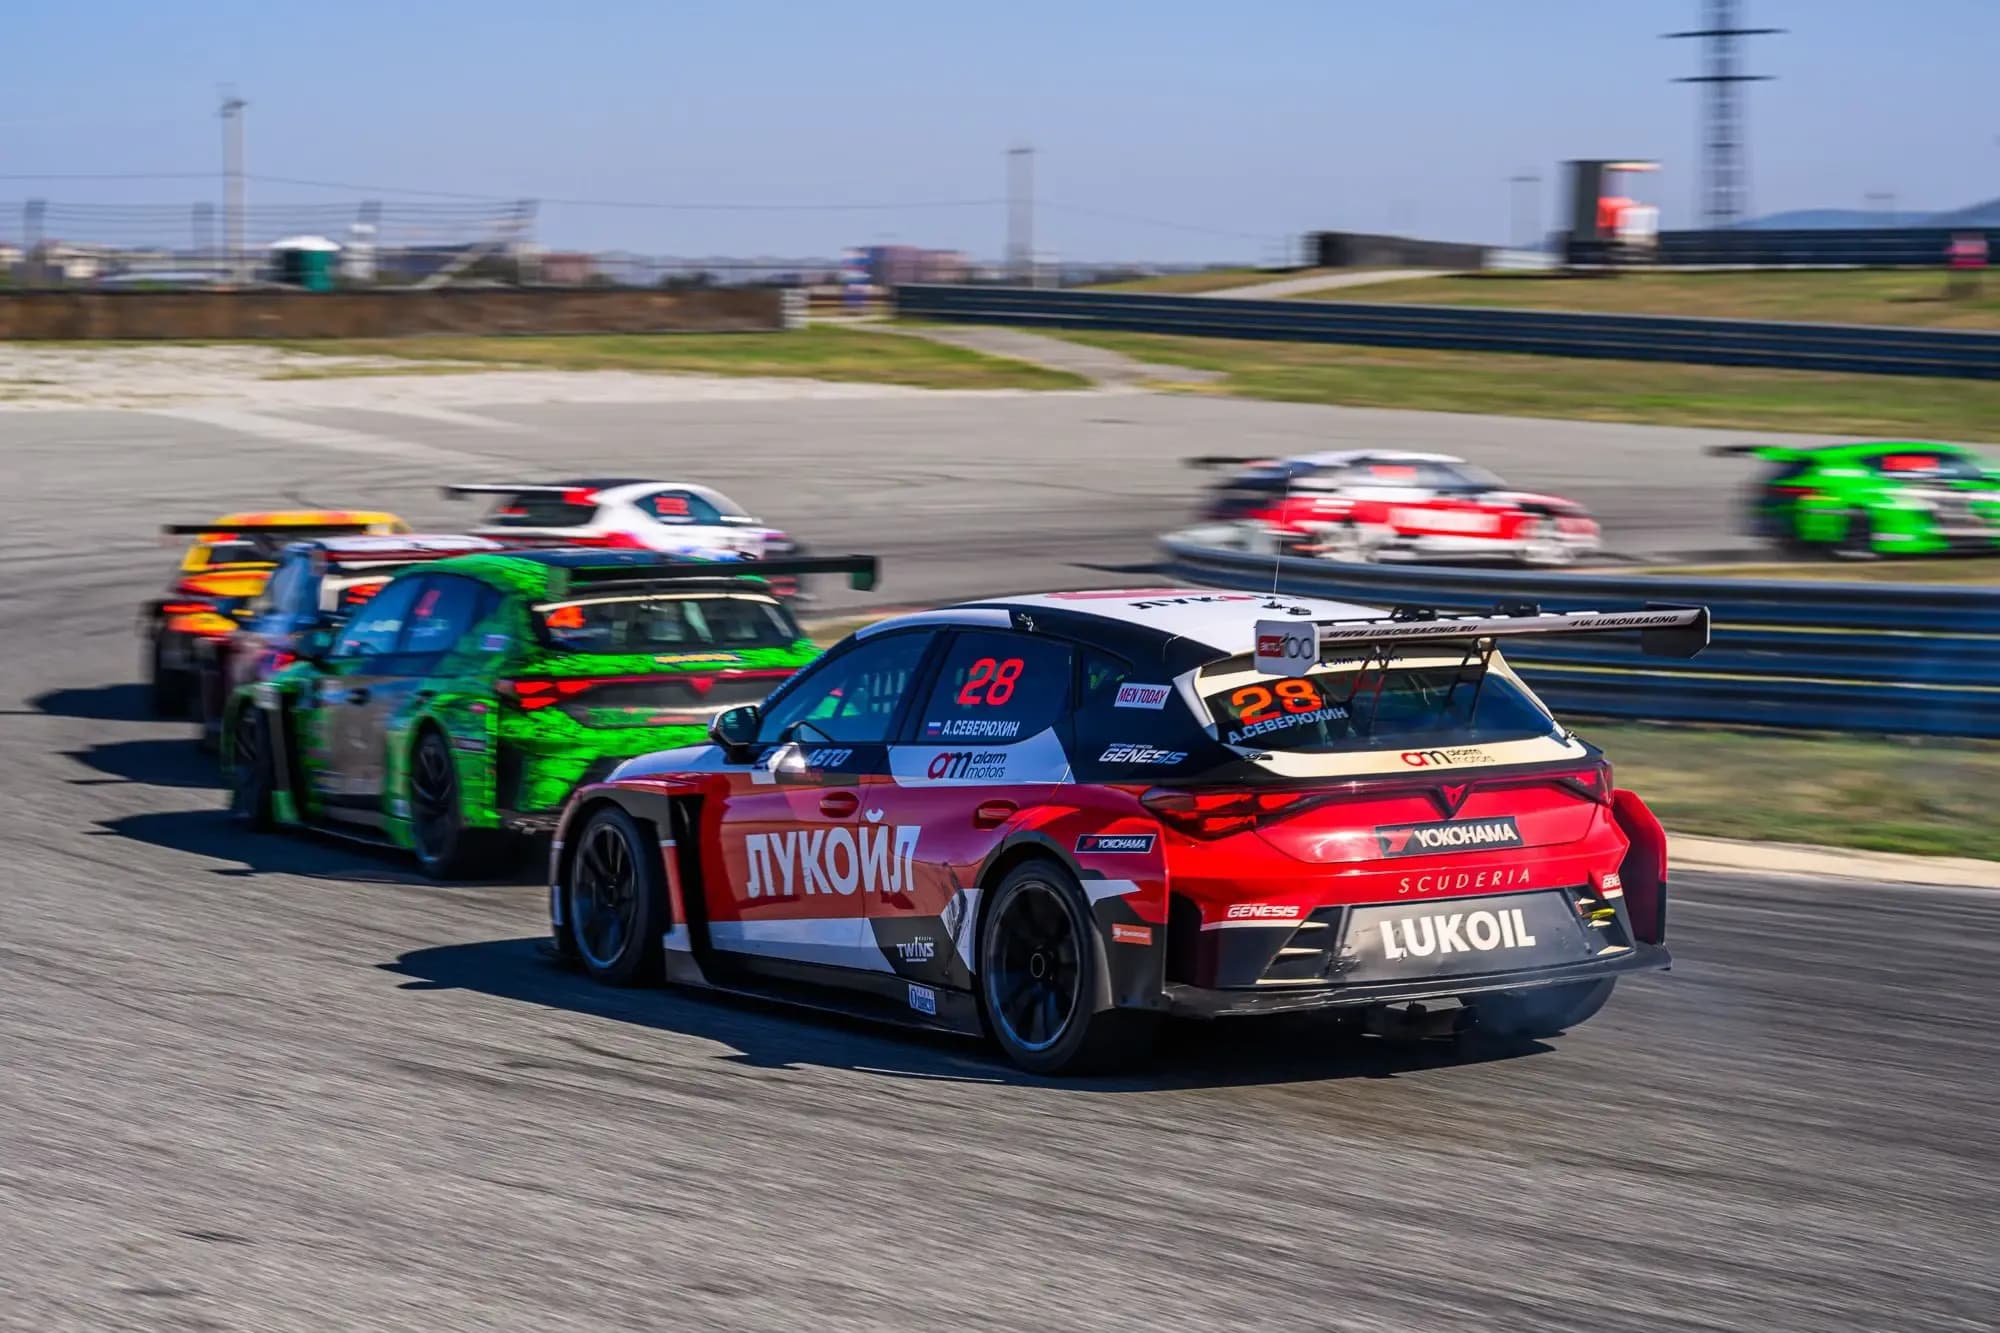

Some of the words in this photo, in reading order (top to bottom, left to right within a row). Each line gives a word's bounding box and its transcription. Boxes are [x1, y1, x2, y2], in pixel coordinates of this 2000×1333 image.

[957, 658, 1025, 706] 28
[1119, 687, 1140, 704] MEN
[1138, 689, 1167, 705] TODAY
[1231, 678, 1323, 725] 28
[941, 720, 1020, 737] А.СЕВЕРЮХИН
[1227, 707, 1349, 745] А.СЕВЕРЮХИН
[972, 751, 1007, 764] alarm
[1098, 748, 1188, 764] GENESIS
[966, 766, 1006, 778] motors
[1098, 839, 1146, 849] YOKOHAMA
[1414, 823, 1518, 848] YOKOHAMA
[745, 807, 922, 898] ЛУКОЙЛ
[1398, 868, 1531, 894] SCUDERIA
[1227, 905, 1300, 918] GENESIS
[1379, 908, 1537, 960] LUKOIL
[896, 936, 934, 958] TWINS
